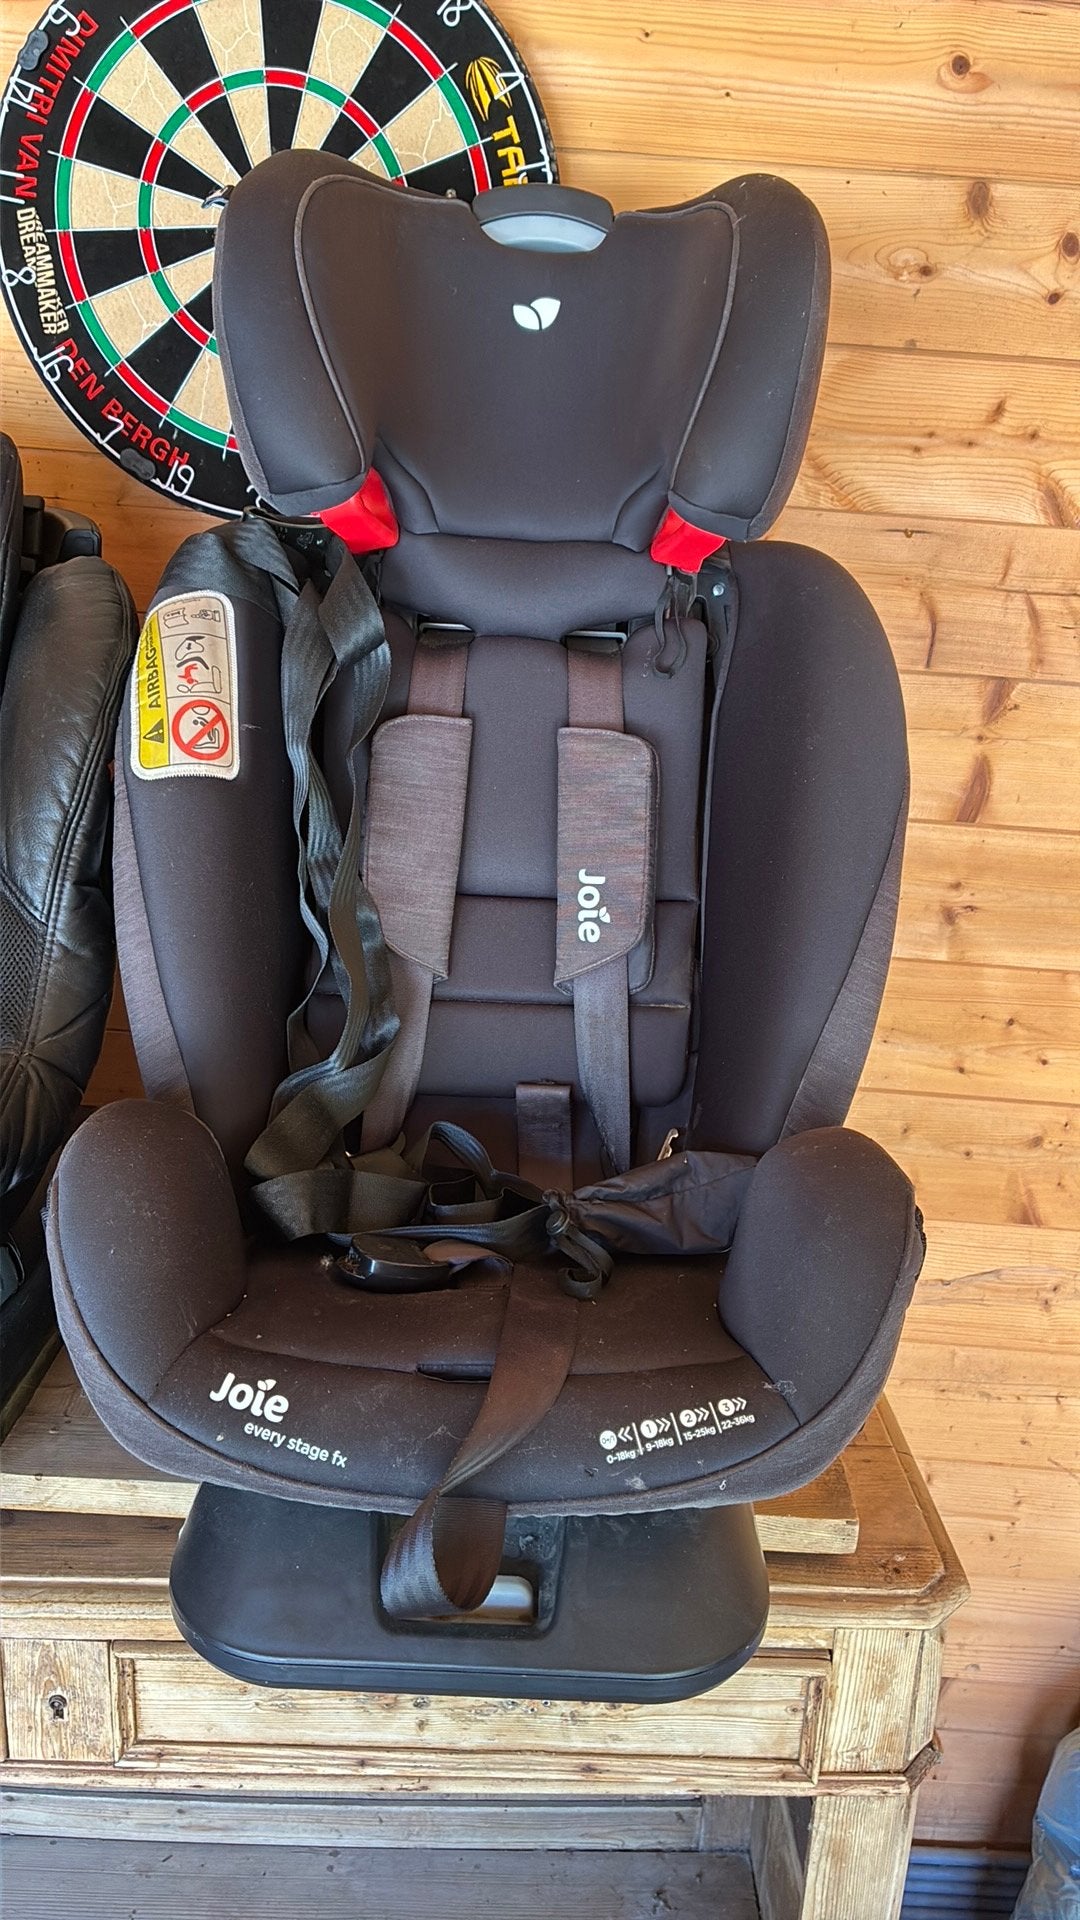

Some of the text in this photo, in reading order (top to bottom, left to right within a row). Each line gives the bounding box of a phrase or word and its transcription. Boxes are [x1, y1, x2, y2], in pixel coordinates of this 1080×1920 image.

[15, 10, 99, 199] DIMITRI VAN
[491, 115, 530, 187] TA
[2, 266, 37, 287] 8
[55, 337, 190, 467] DEN BERGH
[145, 646, 162, 709] AIRBAG
[577, 868, 611, 943] Joie
[209, 1372, 290, 1423] Joie
[244, 1422, 348, 1468] every stage fx
[644, 1437, 675, 1452] 9-18kg
[682, 1426, 717, 1441] 15-25kg
